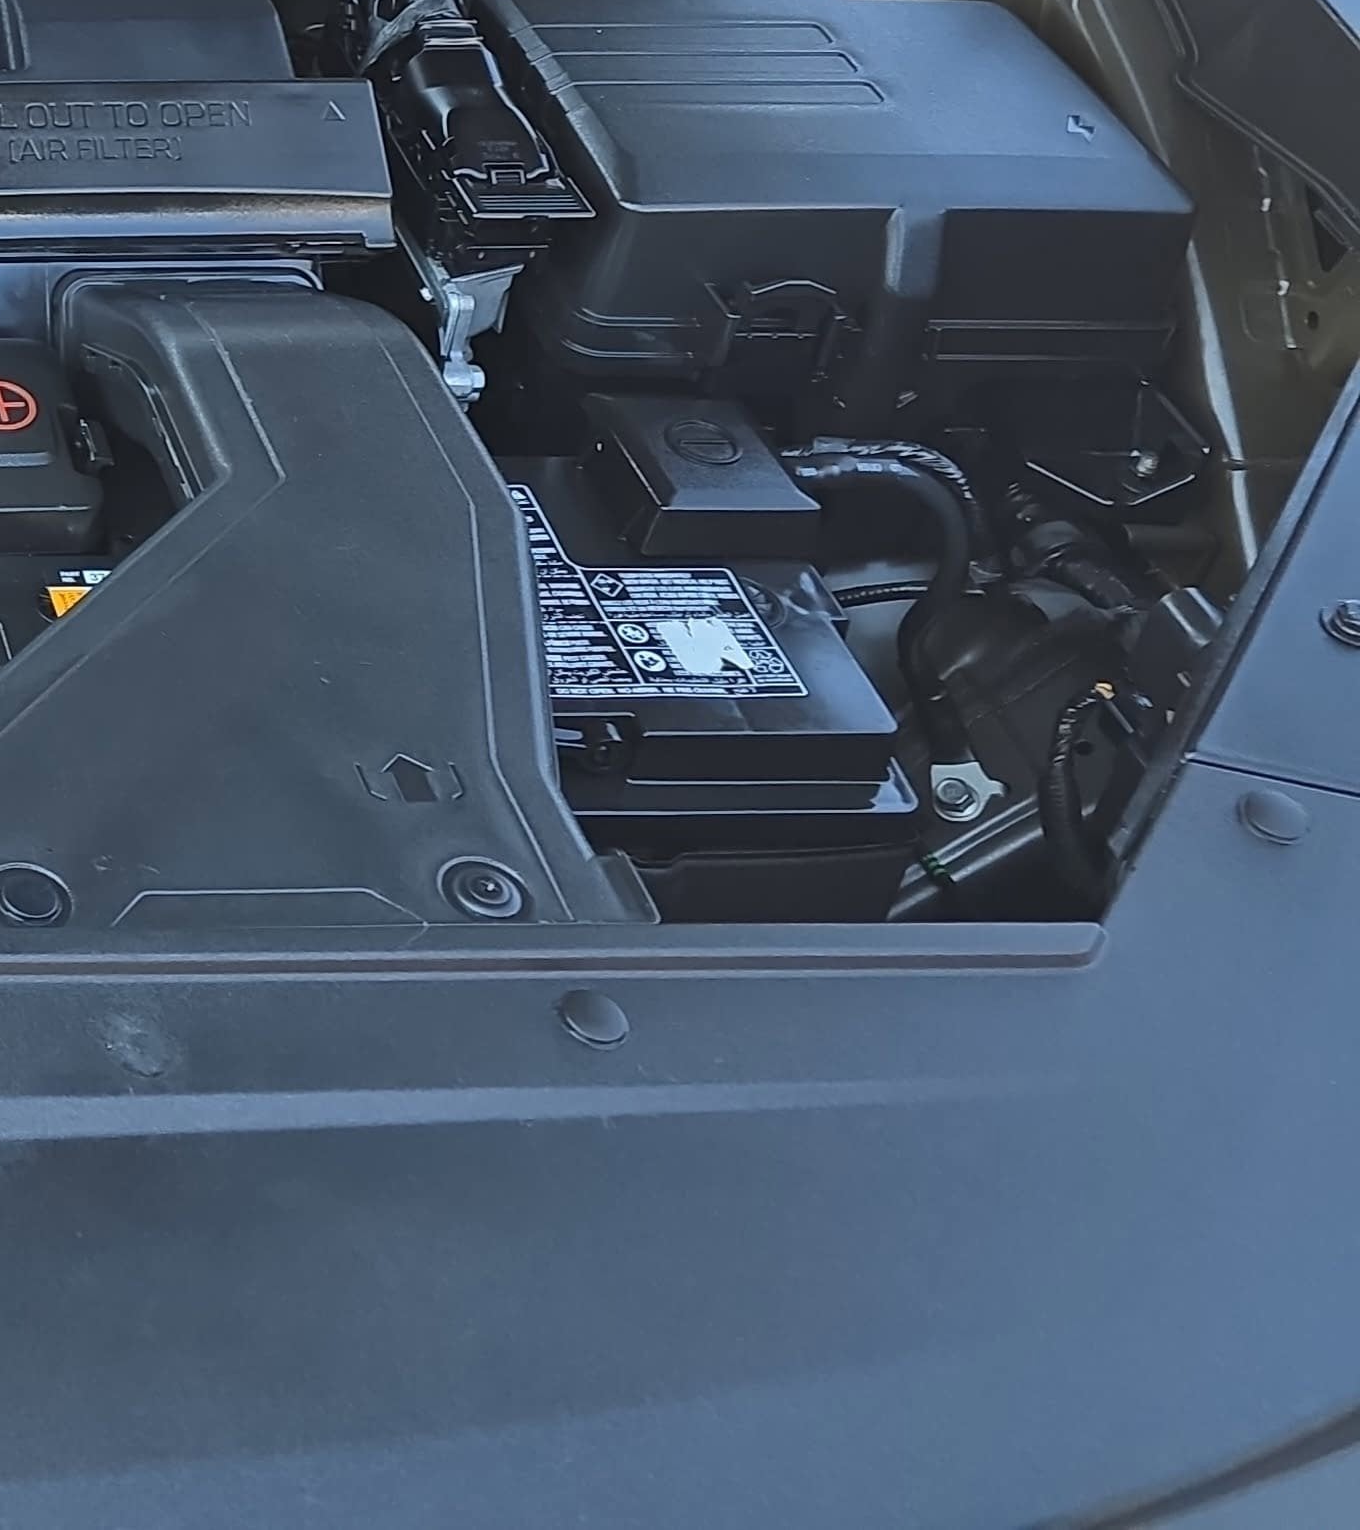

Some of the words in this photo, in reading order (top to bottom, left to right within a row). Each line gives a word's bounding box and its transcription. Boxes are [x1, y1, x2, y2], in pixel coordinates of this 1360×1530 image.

[24, 101, 94, 129] OUT
[102, 101, 148, 128] TO
[156, 100, 252, 127] OPEN
